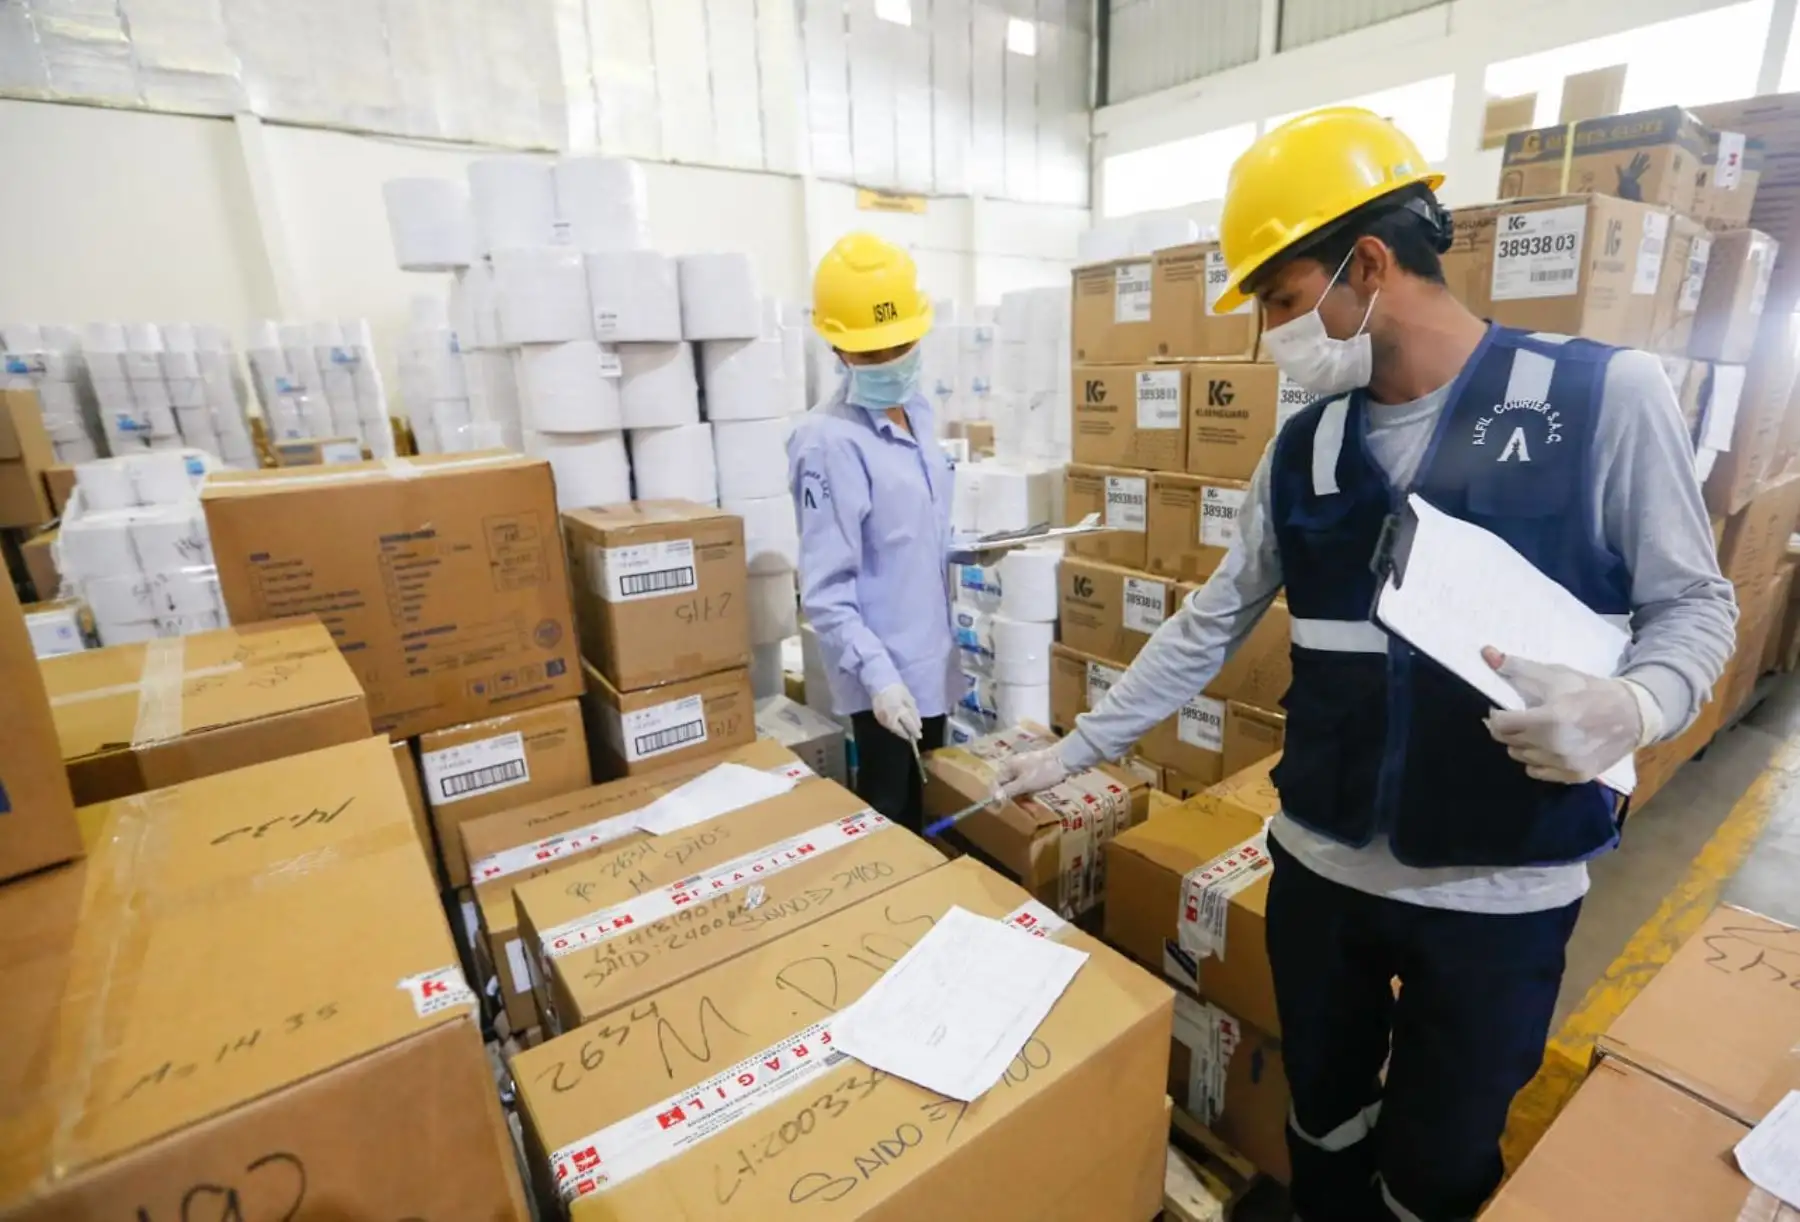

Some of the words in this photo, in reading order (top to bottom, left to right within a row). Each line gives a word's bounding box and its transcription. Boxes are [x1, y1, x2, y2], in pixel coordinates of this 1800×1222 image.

[1498, 235, 1552, 258] 38938
[1555, 233, 1576, 251] 03
[872, 301, 898, 324] ISITA
[1208, 380, 1236, 407] KG
[1472, 416, 1493, 445] ALFIL
[1493, 399, 1552, 415] COURIER
[687, 1030, 832, 1111] FRAGIL
